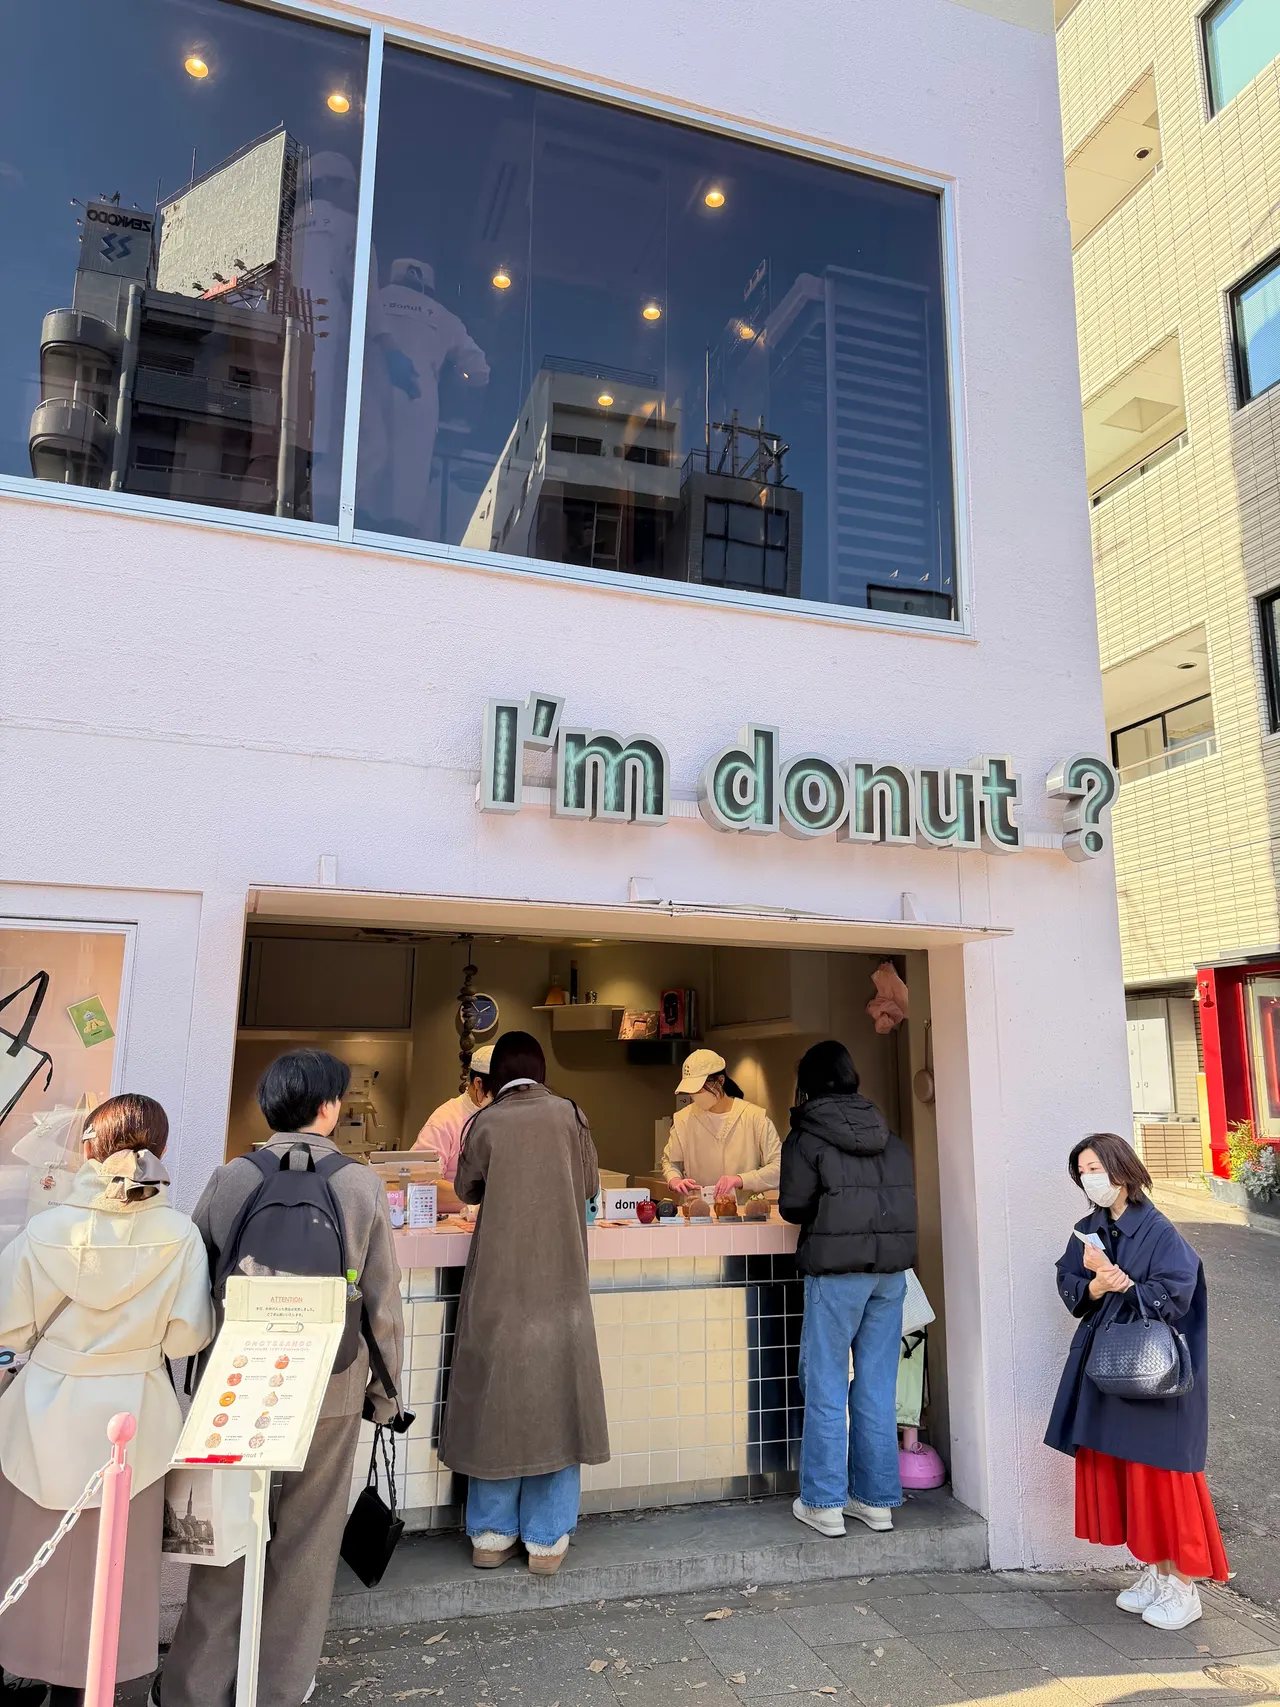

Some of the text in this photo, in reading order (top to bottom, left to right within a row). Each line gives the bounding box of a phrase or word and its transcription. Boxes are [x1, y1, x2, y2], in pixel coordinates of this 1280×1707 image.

[478, 691, 1120, 863] I'm donut ?
[614, 1198, 646, 1210] don
